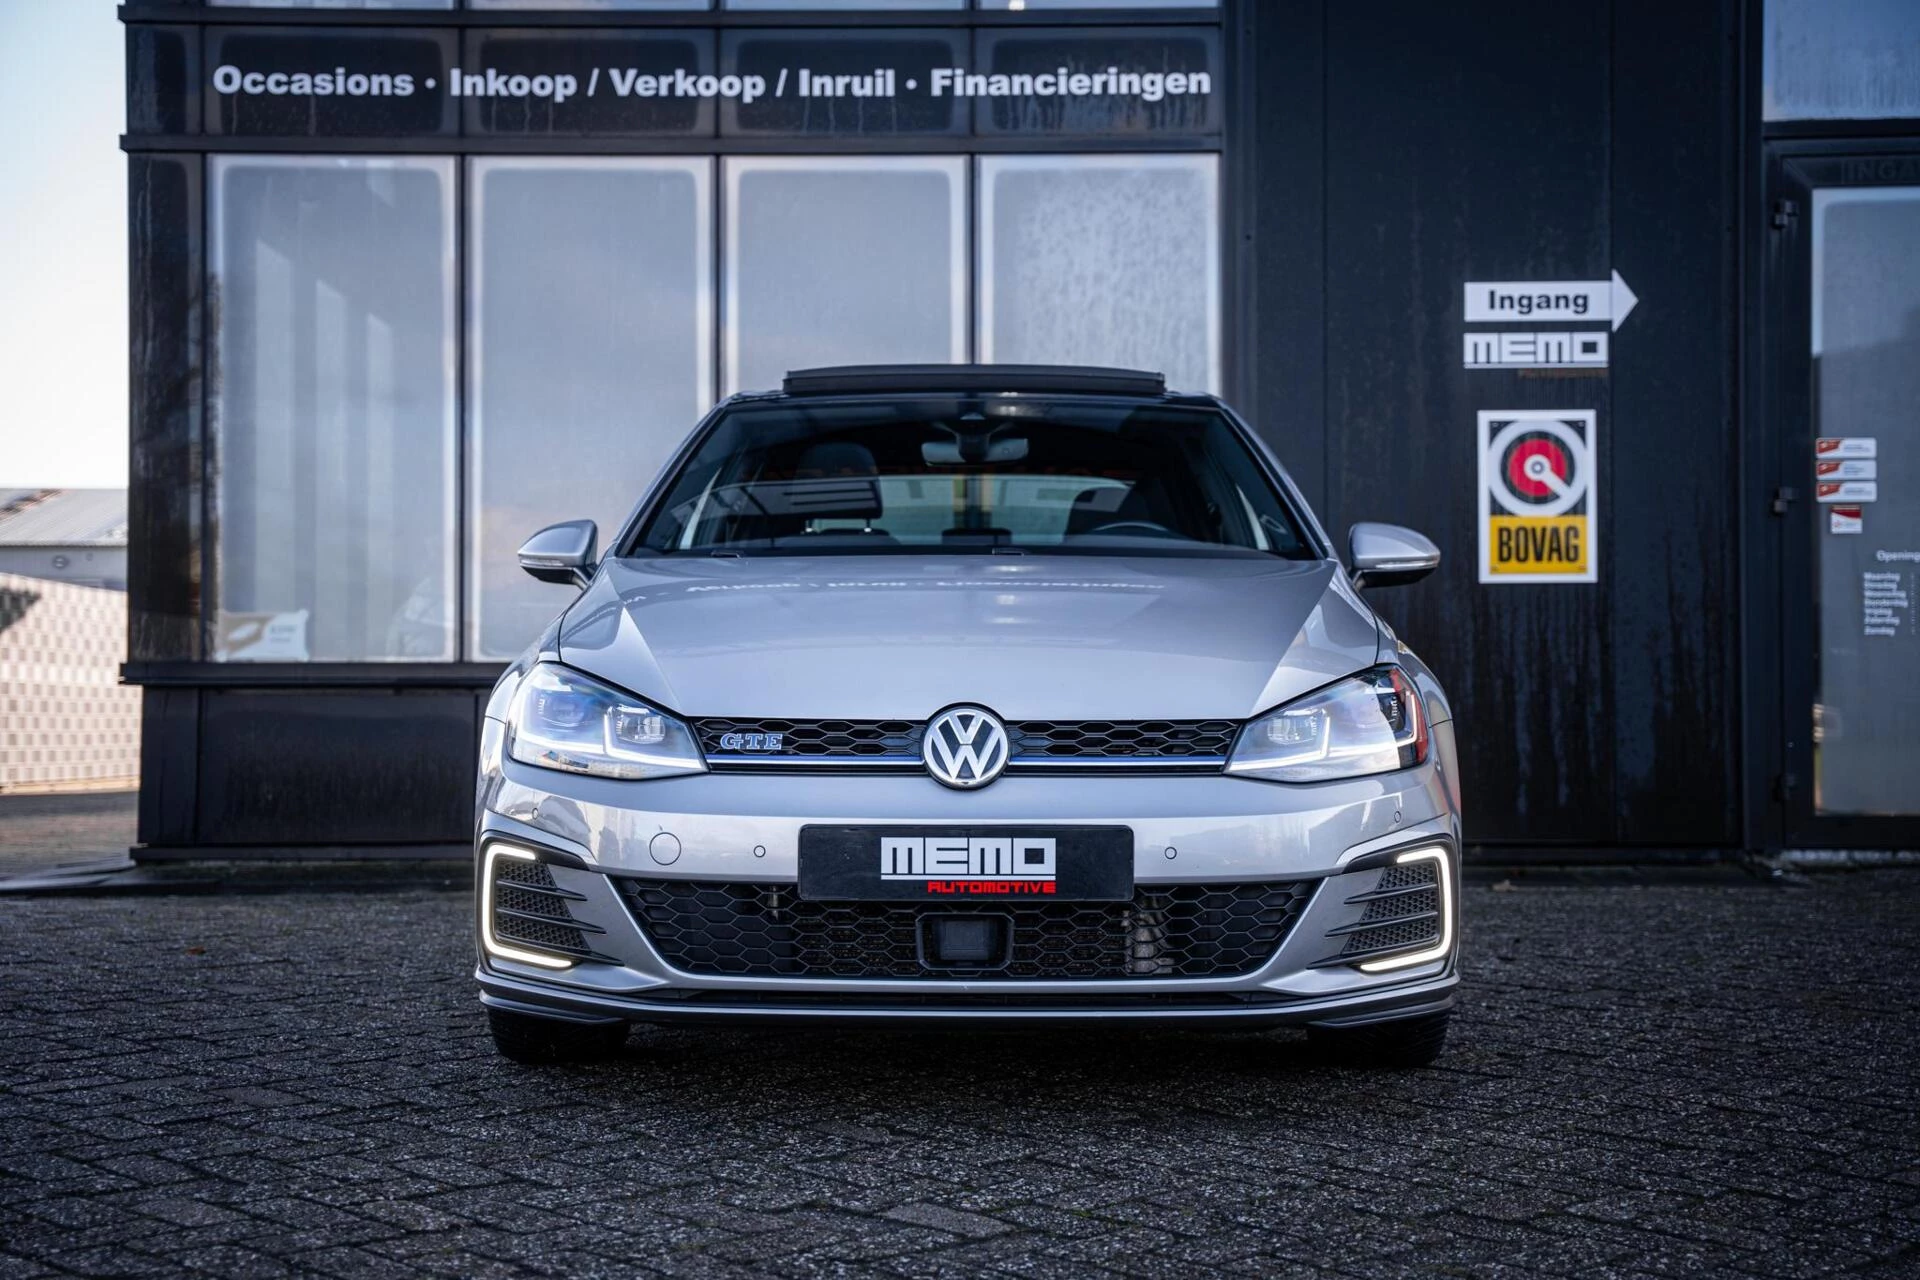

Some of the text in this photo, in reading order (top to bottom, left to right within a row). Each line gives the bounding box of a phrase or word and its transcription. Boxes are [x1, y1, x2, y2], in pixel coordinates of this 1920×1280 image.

[213, 66, 415, 96] Occasions
[450, 68, 577, 103] Inkoop
[609, 68, 769, 103] Verkoop
[799, 67, 896, 97] Inruil
[931, 66, 1211, 102] Financieringen
[1488, 289, 1589, 315] Ingang
[1464, 332, 1608, 363] MEMO
[1498, 525, 1580, 562] BOVAG
[720, 732, 783, 750] GTE
[880, 836, 1057, 876] MEMO
[927, 880, 1057, 894] AUTOMOTIVE
